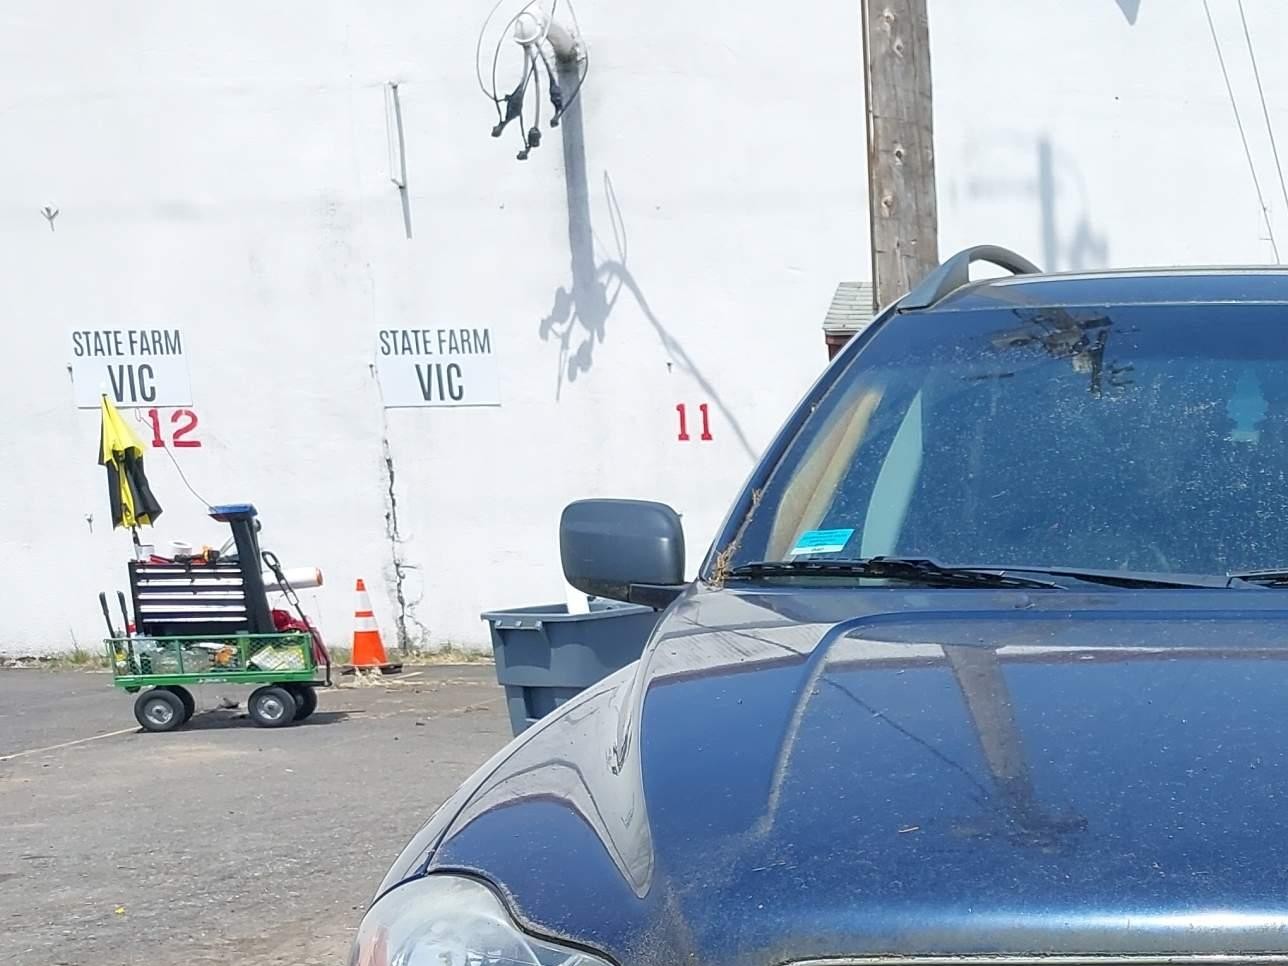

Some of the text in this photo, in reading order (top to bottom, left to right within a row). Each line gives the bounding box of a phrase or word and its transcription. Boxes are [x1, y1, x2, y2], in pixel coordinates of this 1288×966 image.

[72, 330, 182, 357] STATE FARM
[380, 330, 491, 355] STATE FARM
[108, 364, 156, 402] VIC
[415, 364, 464, 401] VIC
[148, 408, 201, 448] 12
[677, 403, 712, 441] 11
